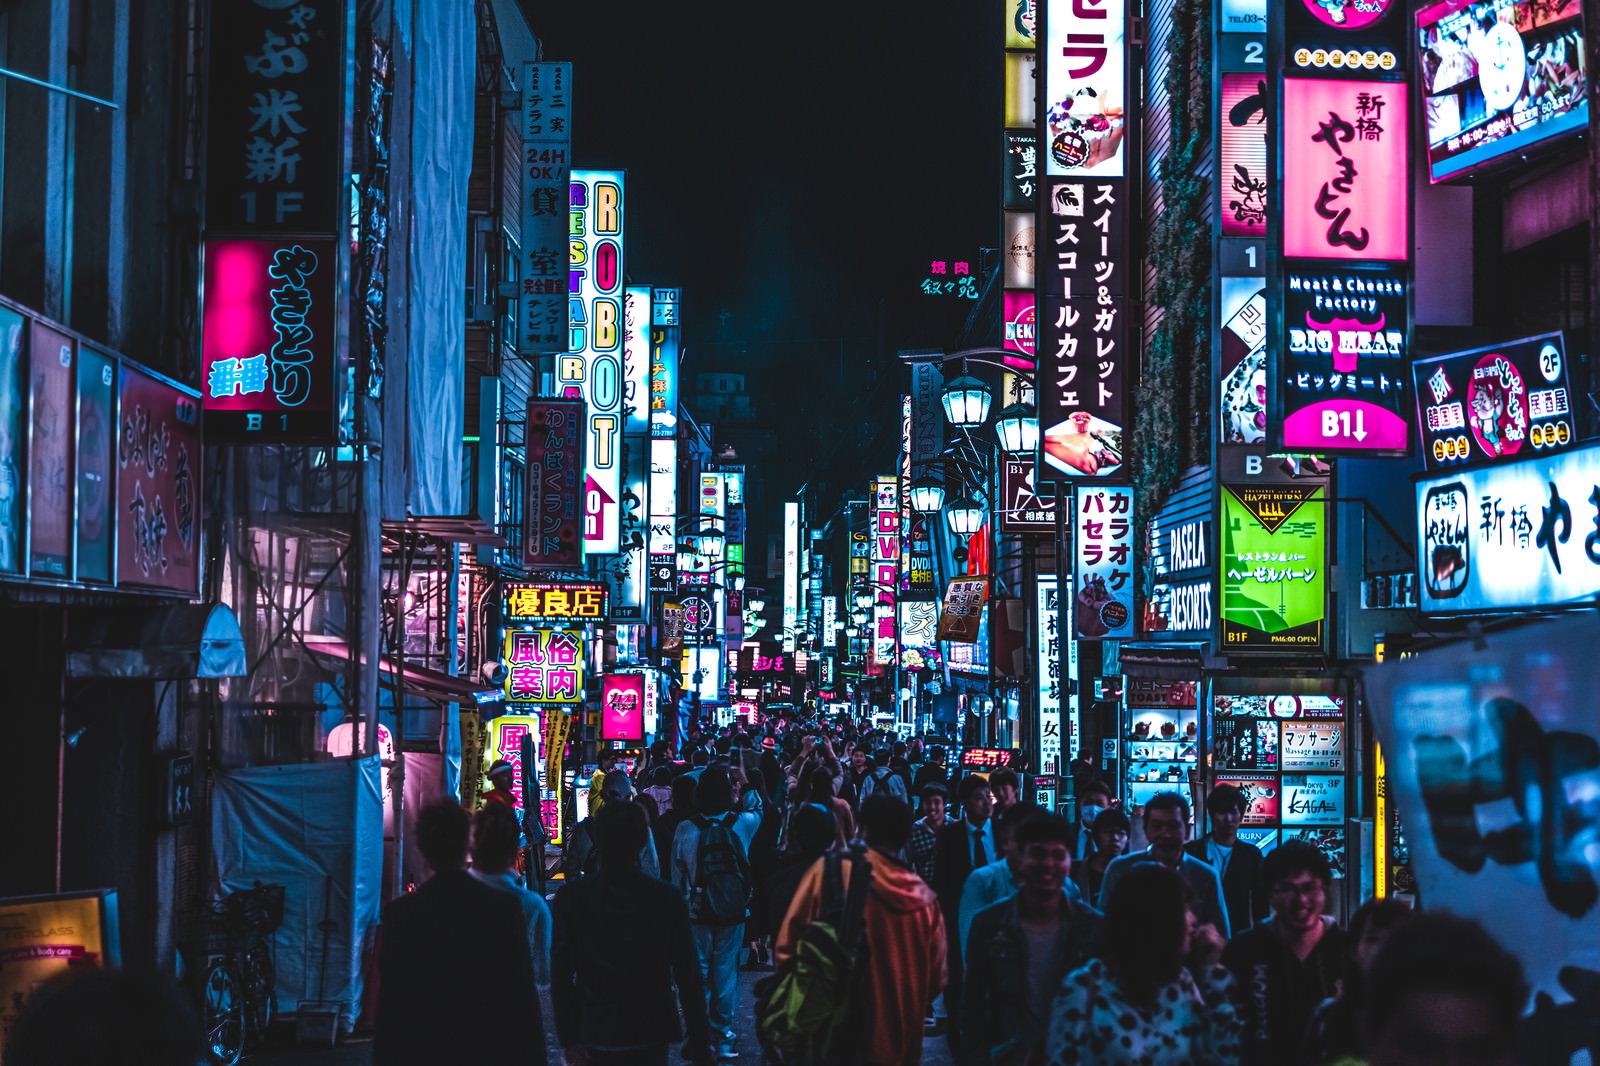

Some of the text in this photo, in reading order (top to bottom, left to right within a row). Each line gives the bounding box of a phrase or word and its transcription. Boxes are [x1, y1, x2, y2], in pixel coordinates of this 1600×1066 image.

[1245, 42, 1264, 63] 2
[528, 94, 543, 135] テラコ
[1355, 93, 1386, 142] 新橋
[527, 149, 565, 164] 24H
[530, 167, 562, 181] OK!
[530, 188, 561, 277] 貸室
[1245, 246, 1257, 267] 1
[931, 261, 969, 274] 焼肉
[920, 276, 979, 299] 叙々苑
[1092, 184, 1118, 407] スイーツ&ガレット
[1290, 277, 1402, 293] Meat & Cheese
[1315, 296, 1378, 312] Factory
[594, 185, 618, 466] ROBOT
[1055, 223, 1081, 407] スコールカフェ
[269, 245, 319, 407] やきとり
[1290, 329, 1402, 354] BIG MEAT
[1543, 355, 1558, 373] 2F
[1322, 410, 1351, 438] B1
[1246, 456, 1263, 474] B
[1082, 492, 1105, 567] パセラ
[1480, 496, 1533, 549] 新橋
[1108, 493, 1131, 591] カラオケ
[1170, 520, 1206, 572] PASELA
[1227, 566, 1317, 583] ヘーゼルバーン
[952, 581, 985, 595] 悪質な
[509, 588, 603, 618] 優良店
[946, 605, 979, 619] に注意
[1170, 581, 1211, 631] RESORTS
[511, 631, 579, 664] 風俗
[1228, 632, 1248, 642] B1F
[512, 666, 579, 700] 案内
[1130, 693, 1168, 702] TOAST
[1284, 728, 1342, 749] マッサージ
[1266, 754, 1278, 763] 4F
[1284, 747, 1312, 757] Massage
[1329, 759, 1340, 769] 5F
[1327, 779, 1340, 789] 3F
